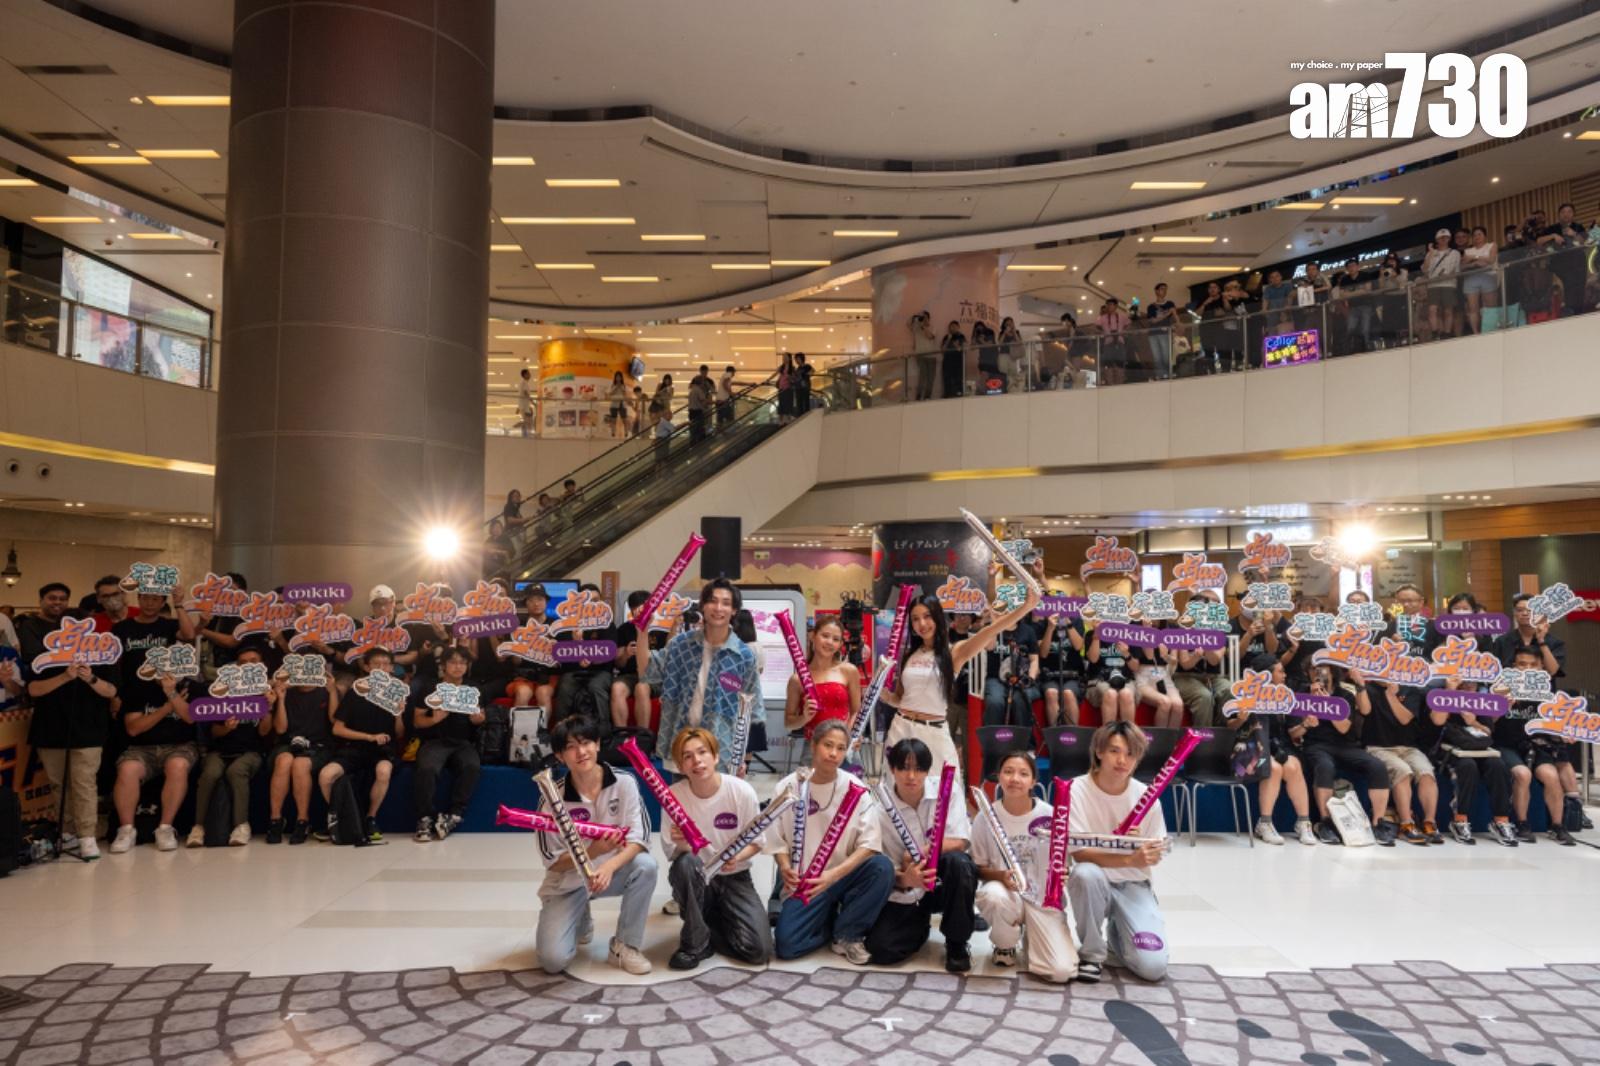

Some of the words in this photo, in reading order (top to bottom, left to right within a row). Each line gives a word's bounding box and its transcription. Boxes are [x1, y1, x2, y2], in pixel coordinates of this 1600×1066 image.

[1320, 258, 1350, 271] Drea
[1358, 248, 1390, 262] Team
[650, 558, 687, 607] mikiki
[287, 587, 346, 600] mikiki
[458, 618, 512, 636] mikiki
[1440, 618, 1502, 630] mikiki
[1102, 625, 1156, 645] mikiki
[1163, 630, 1218, 646] mikiki
[556, 645, 610, 658] mikiki
[788, 635, 812, 691] mikiki
[195, 701, 261, 716] mikiki
[1433, 695, 1500, 712] mikiki
[1133, 755, 1179, 815] mikiki
[642, 766, 688, 827] mikiki
[720, 813, 774, 862] mikiki
[810, 813, 849, 875] mikiki
[1052, 805, 1068, 873] mikiki
